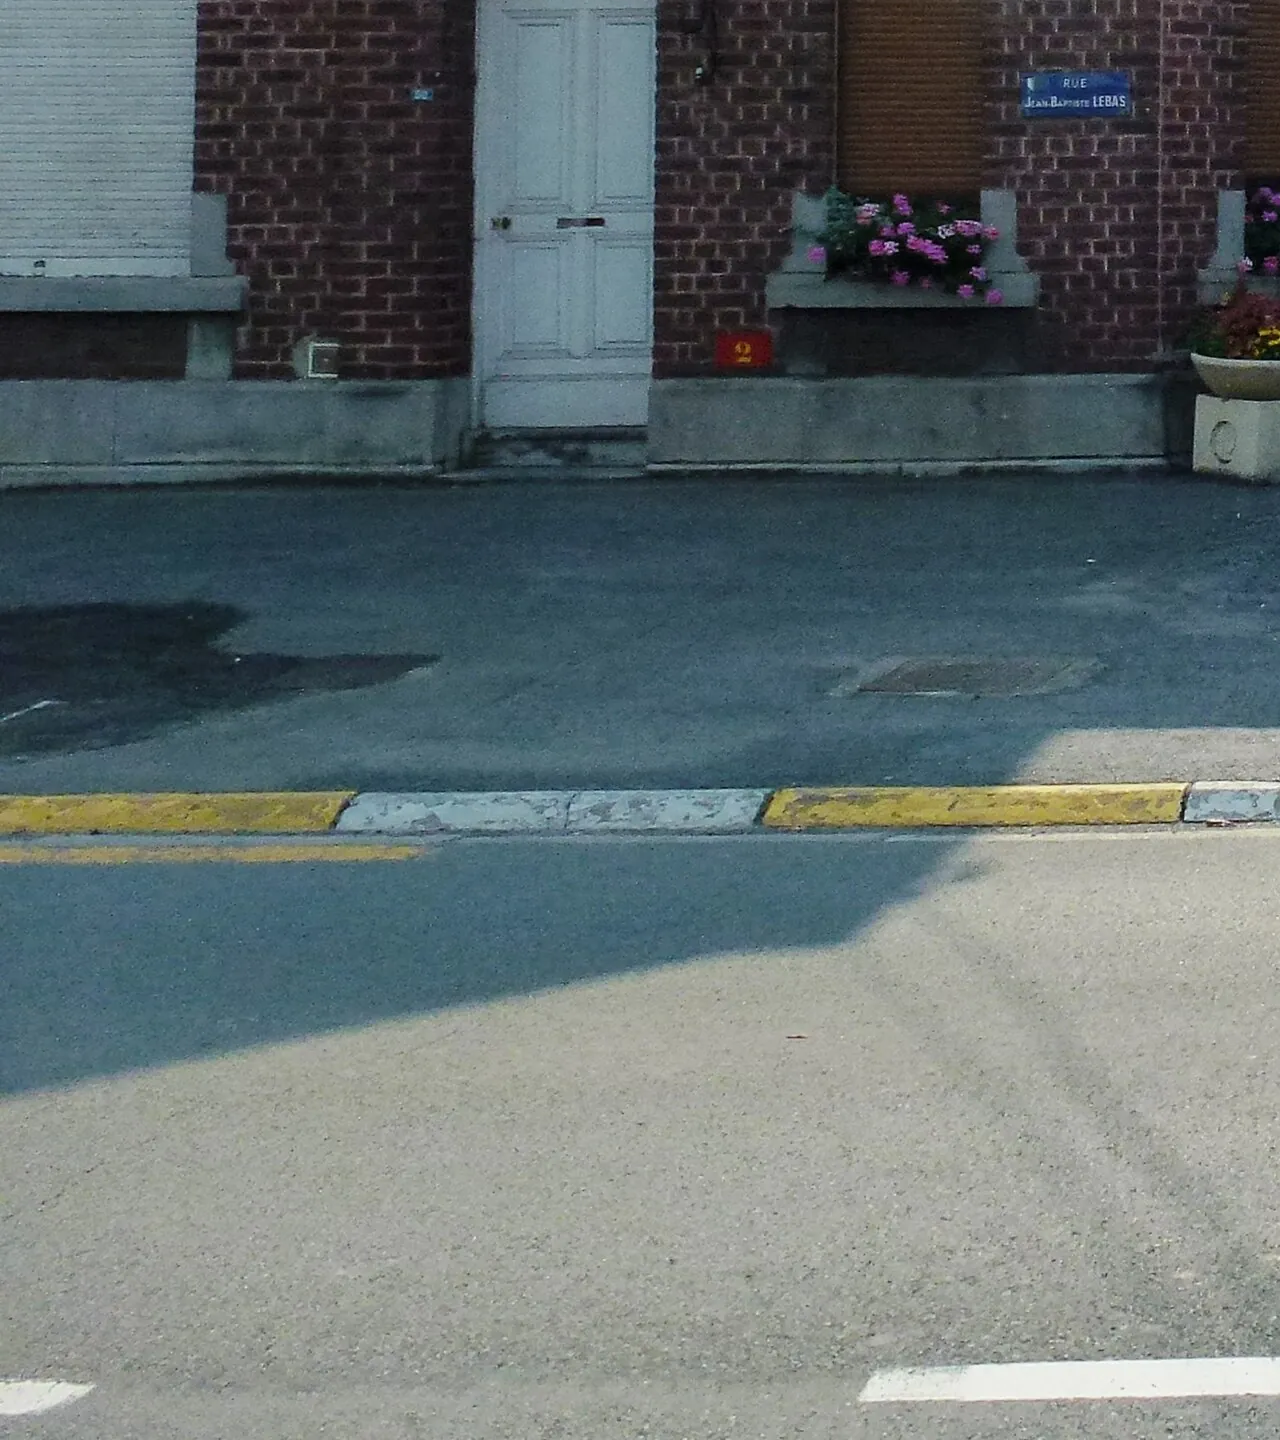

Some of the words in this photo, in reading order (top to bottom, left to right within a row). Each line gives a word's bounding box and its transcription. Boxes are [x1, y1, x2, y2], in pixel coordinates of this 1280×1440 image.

[1063, 78, 1088, 88] RUE
[1093, 95, 1126, 107] LEBAS
[734, 341, 752, 364] 2
